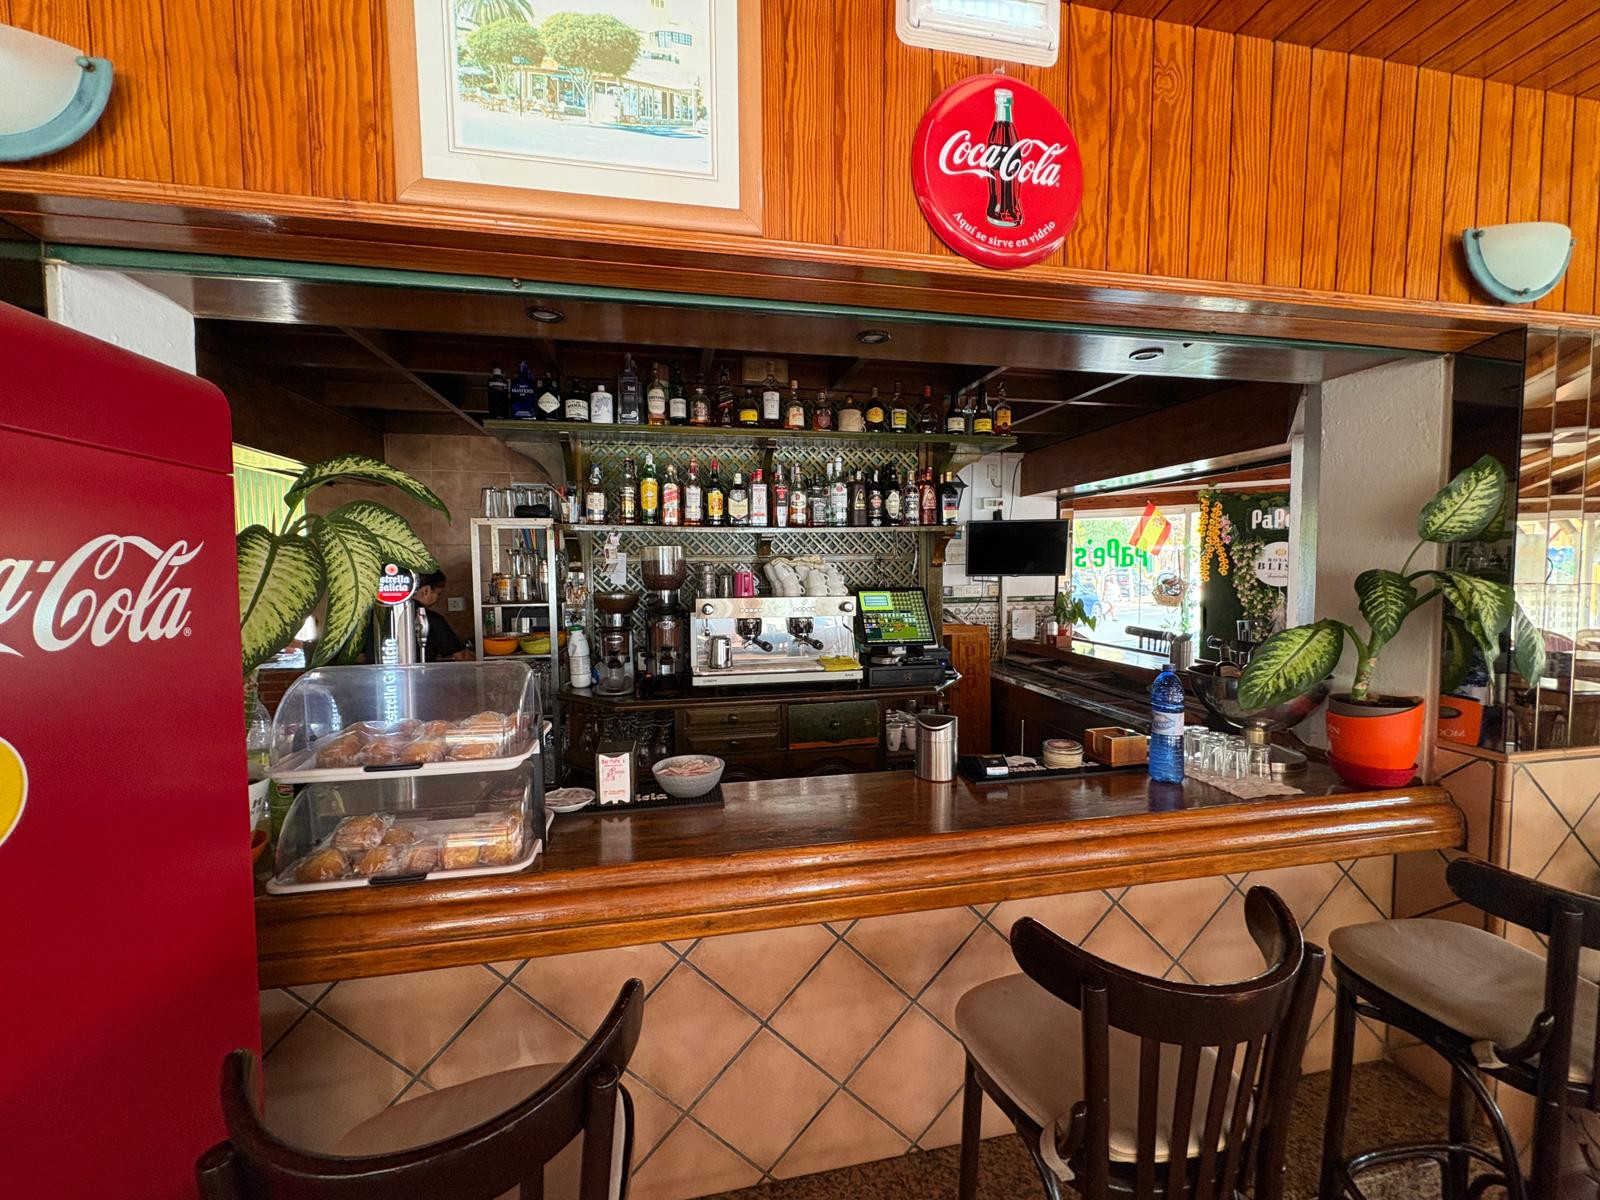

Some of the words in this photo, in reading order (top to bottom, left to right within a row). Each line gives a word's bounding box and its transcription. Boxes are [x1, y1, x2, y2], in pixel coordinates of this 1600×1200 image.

[938, 130, 1068, 186] Coca-Cola
[953, 211, 976, 235] Aquí
[975, 231, 987, 241] se
[988, 237, 1014, 248] sirve
[1016, 237, 1028, 248] en
[1029, 220, 1056, 244] vidrio
[379, 575, 410, 584] strella
